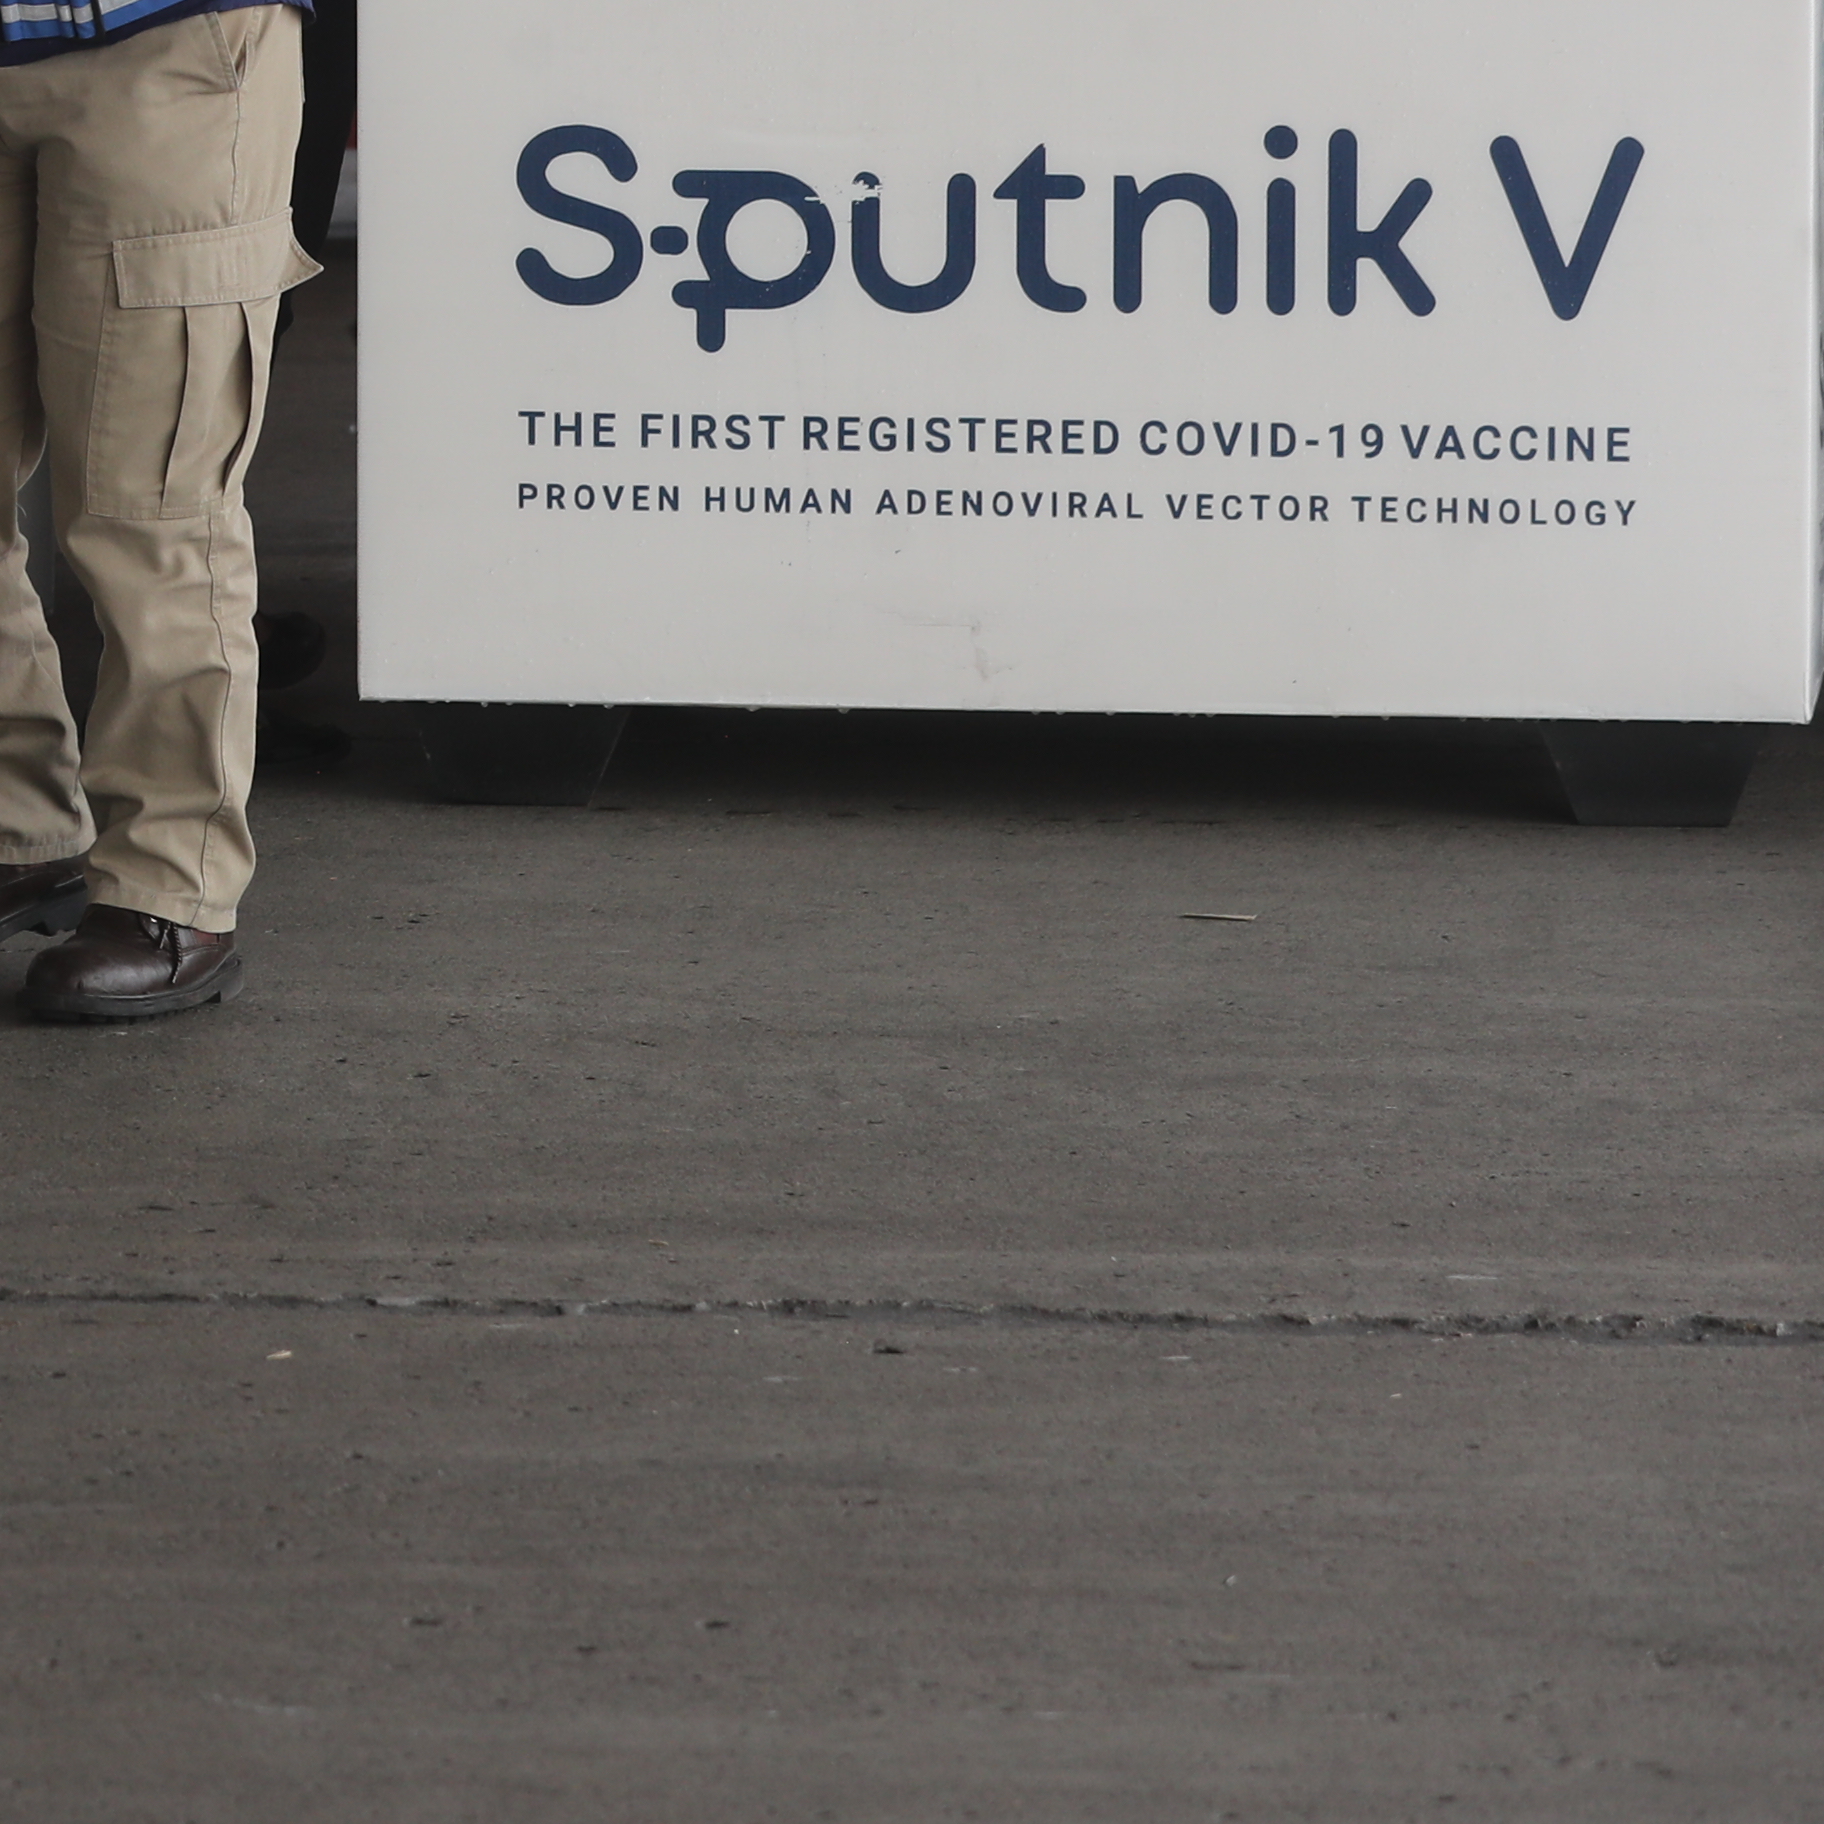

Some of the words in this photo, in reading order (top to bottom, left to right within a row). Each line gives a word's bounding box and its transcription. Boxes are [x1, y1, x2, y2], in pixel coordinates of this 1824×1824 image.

[1490, 136, 1644, 321] V
[518, 411, 616, 447] THE
[641, 414, 785, 450] FIRST
[803, 416, 1119, 454] REGISTERED
[1140, 420, 1383, 458] COVID-19
[1400, 425, 1630, 462] VACCINE
[519, 483, 678, 511] PROVEN
[705, 486, 851, 514] HUMAN
[876, 489, 1143, 518] ADENOVIRAL
[1166, 494, 1328, 521] VECTOR
[1351, 496, 1635, 526] TECHNOLOGY
